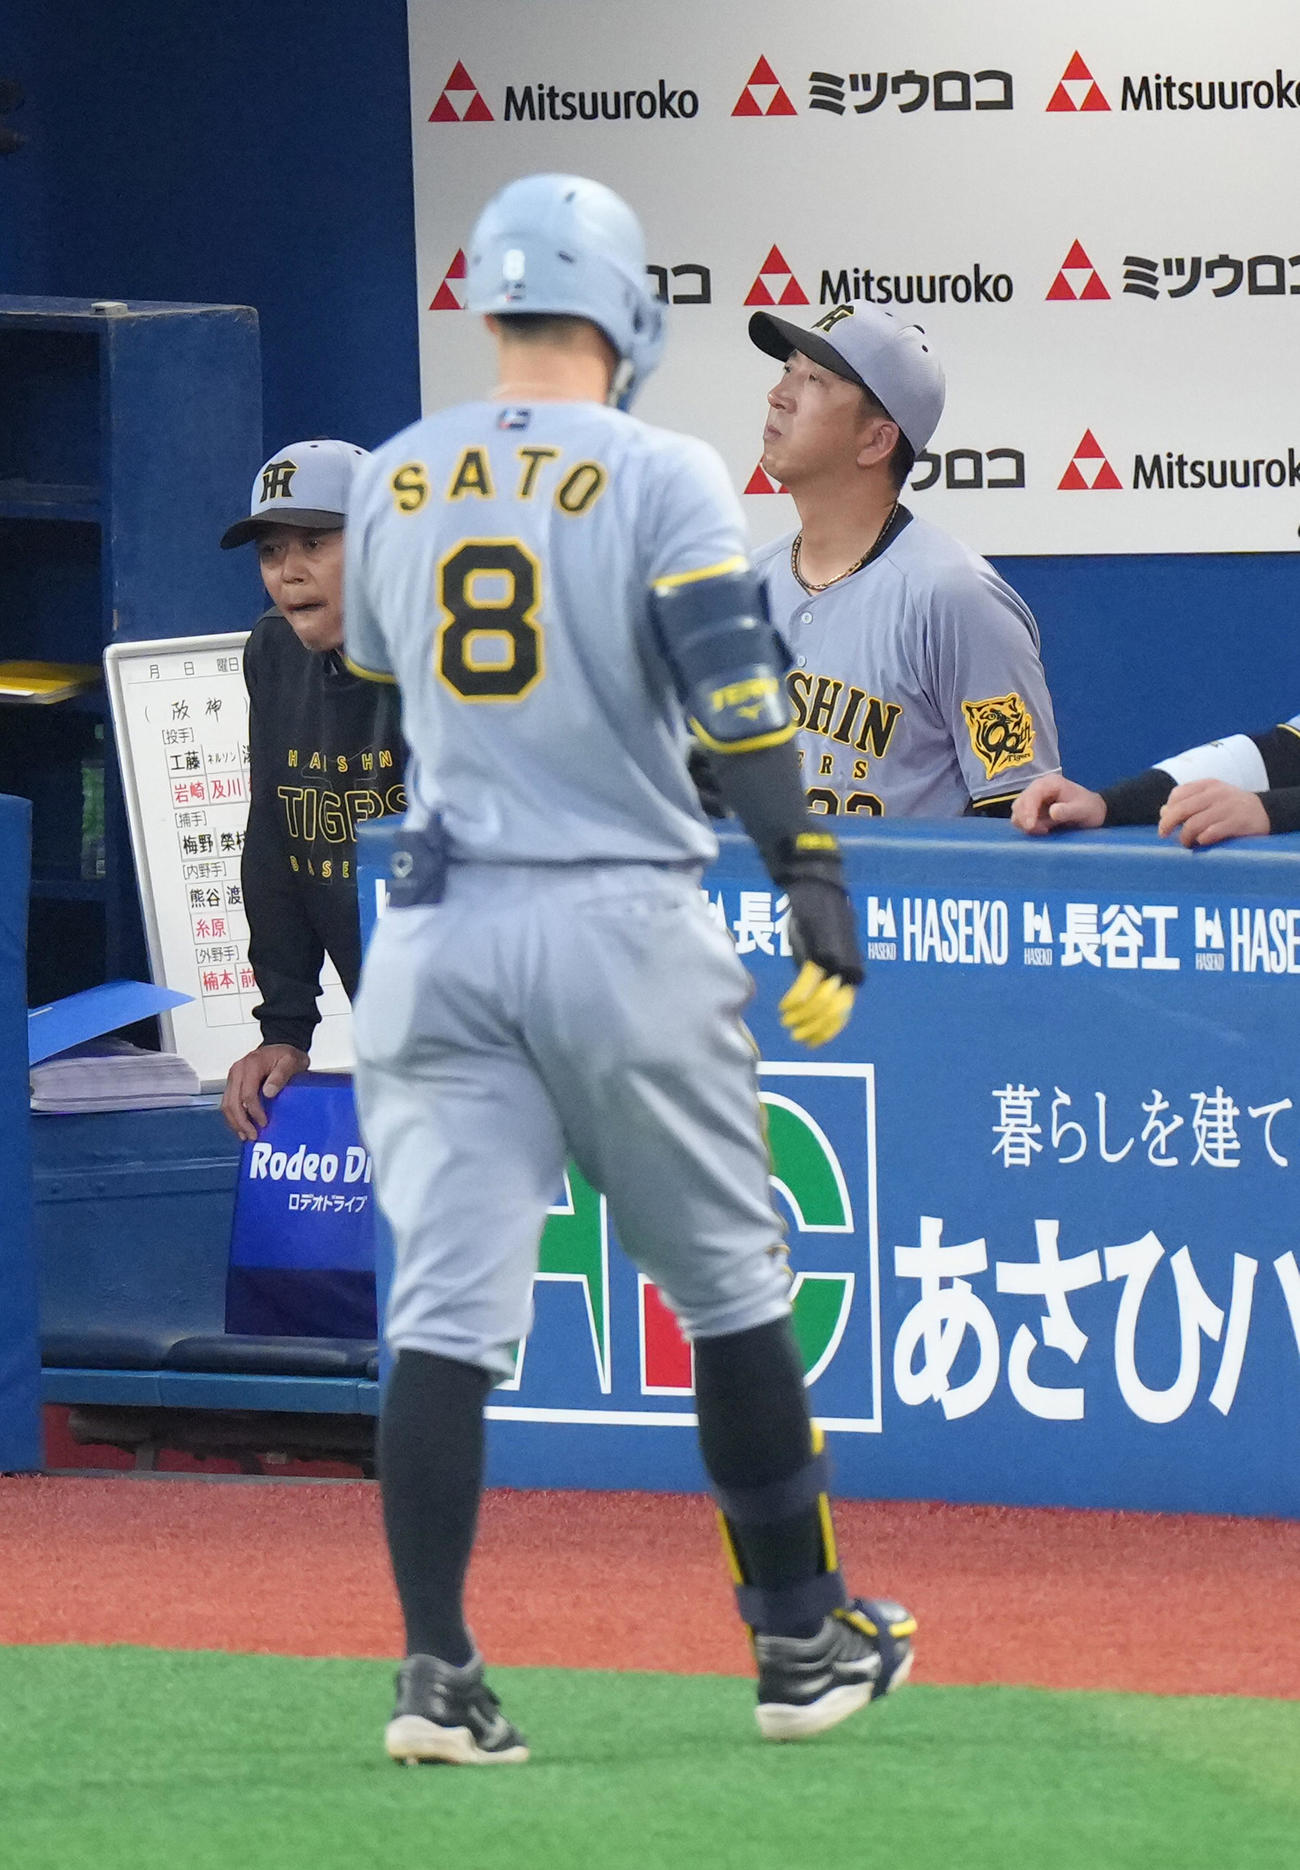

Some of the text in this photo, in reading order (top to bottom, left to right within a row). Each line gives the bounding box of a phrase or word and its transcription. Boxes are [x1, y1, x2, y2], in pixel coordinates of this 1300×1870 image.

[503, 79, 699, 121] Mitsuuroko
[808, 69, 1014, 116] ミツウロコ
[1121, 69, 1300, 111] Mitsuurok
[820, 263, 1014, 305] Mitsuuroko
[389, 446, 608, 517] SATO
[434, 537, 546, 703] 8
[184, 661, 195, 676] 日
[169, 751, 201, 771] 工藤
[211, 778, 242, 799] 及川
[183, 833, 214, 855] 梅野
[190, 887, 220, 909] 熊谷
[196, 918, 227, 939] 糸原
[903, 897, 1008, 965] HASEKO
[1059, 903, 1181, 970] 長谷工
[867, 942, 897, 961] HASEKO
[1024, 947, 1053, 966] HASEKO
[992, 1083, 1293, 1168] 暮らしを建て
[250, 1142, 339, 1183] Rodeo
